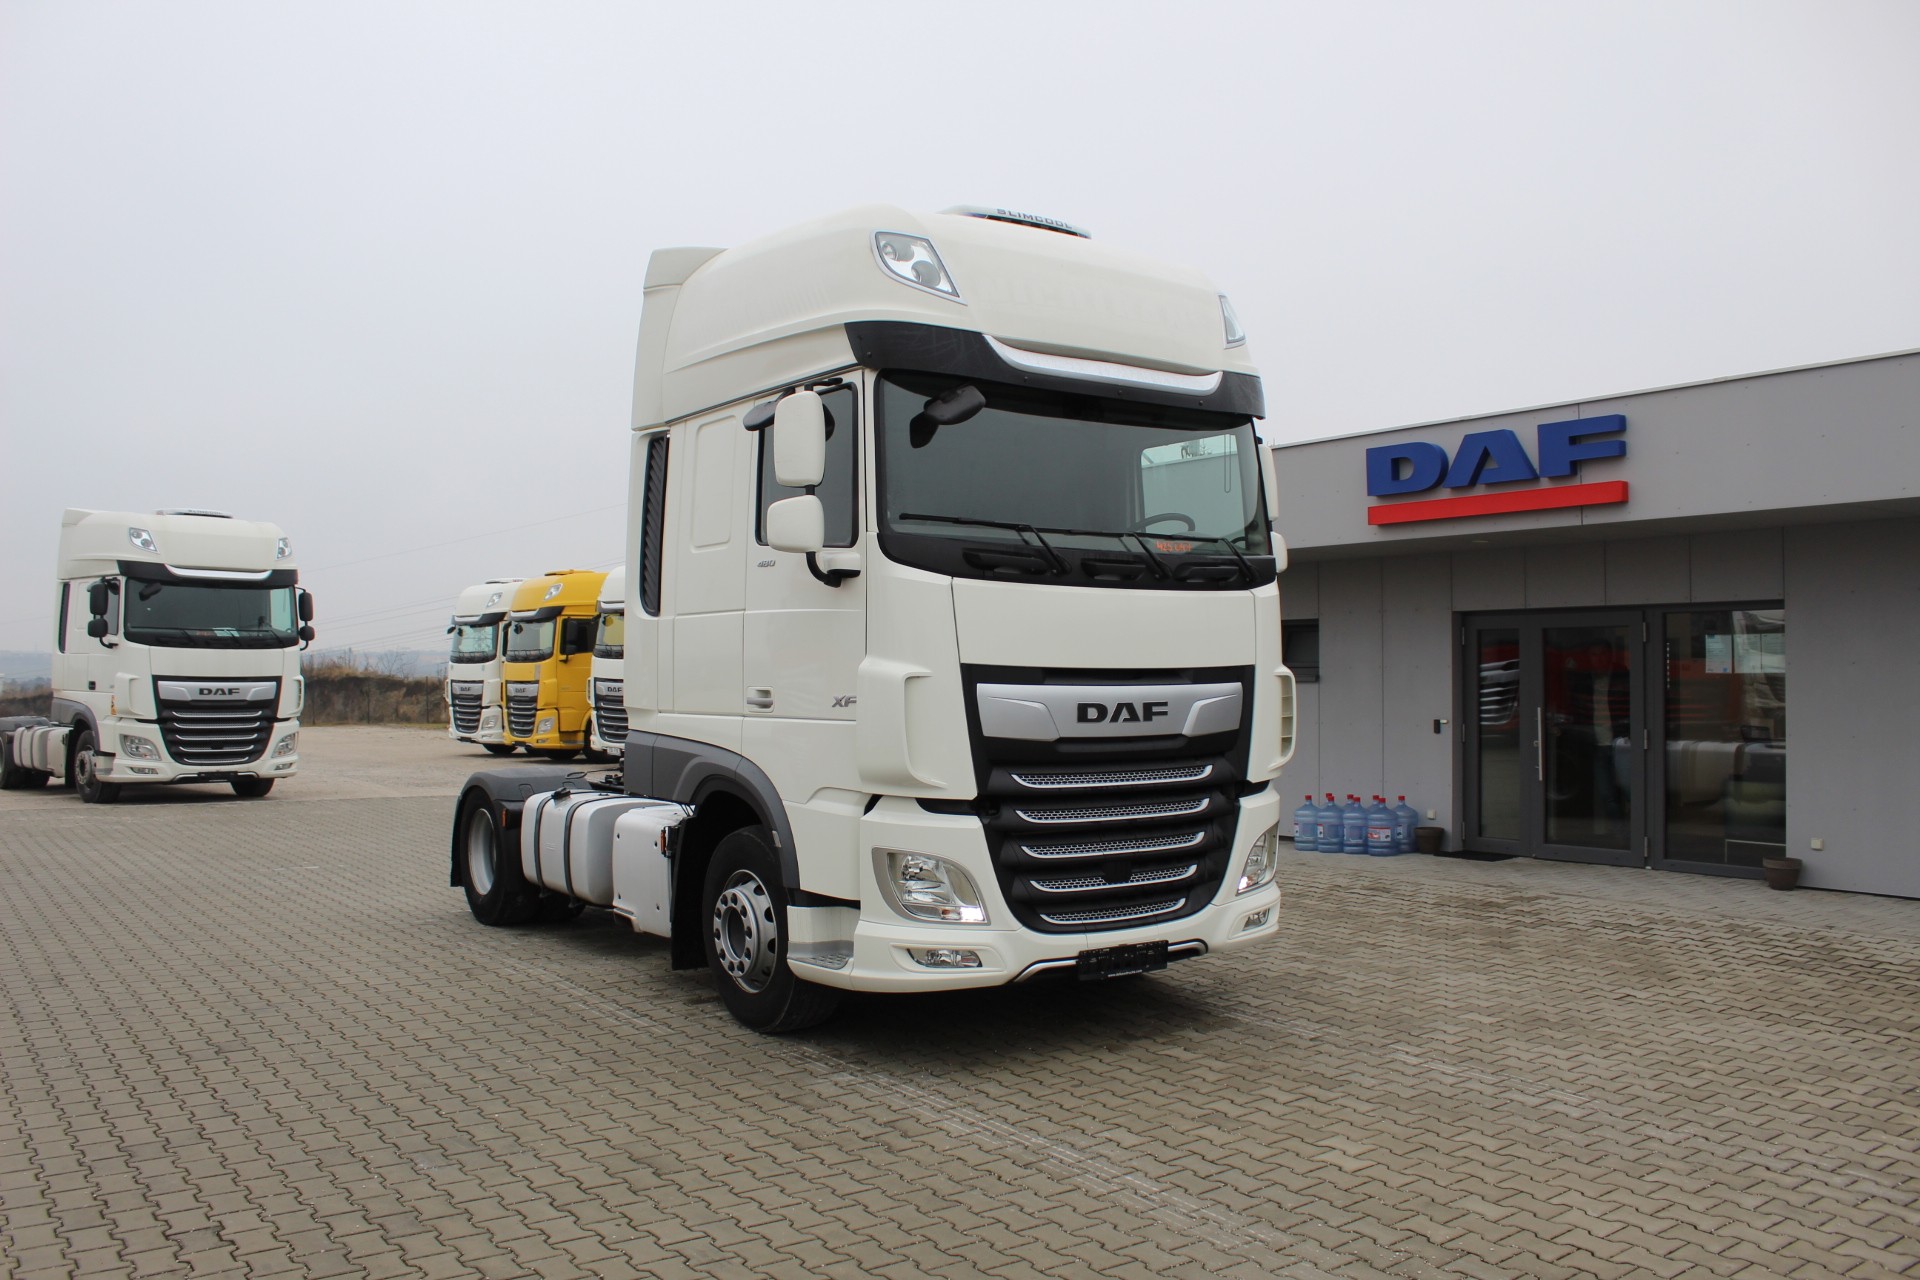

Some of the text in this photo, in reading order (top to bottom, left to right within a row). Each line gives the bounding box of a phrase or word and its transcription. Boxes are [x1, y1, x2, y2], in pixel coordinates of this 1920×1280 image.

[996, 208, 1073, 230] SLIMCOOL
[1366, 414, 1627, 496] DAF
[199, 687, 240, 696] DAF
[832, 695, 857, 707] XF
[1077, 701, 1168, 723] DAF
